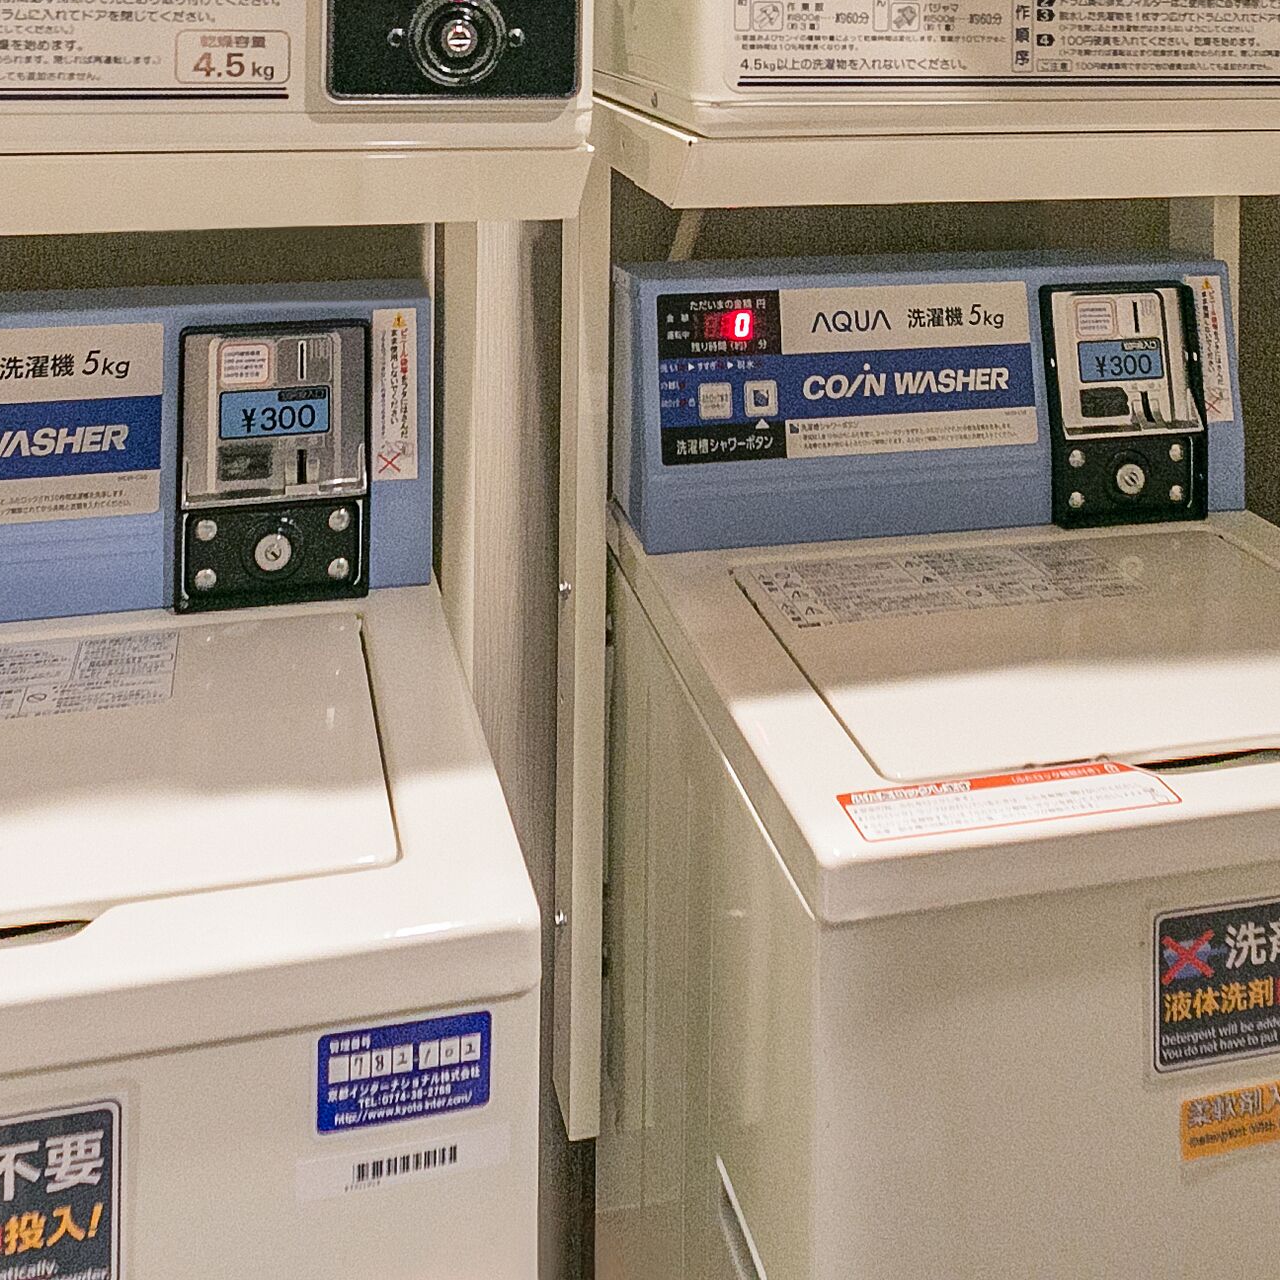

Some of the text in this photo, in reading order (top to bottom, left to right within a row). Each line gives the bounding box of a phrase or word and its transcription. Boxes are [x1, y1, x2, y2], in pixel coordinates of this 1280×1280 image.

[756, 299, 766, 309] 円
[907, 303, 1005, 330] 洗濯機 5kg
[734, 313, 750, 337] 0
[811, 309, 892, 334] AQUA
[758, 339, 767, 349] 分
[0, 349, 132, 380] 洗濯機 5kg
[1096, 354, 1152, 378] ¥300
[894, 367, 1009, 395] WASHER
[242, 405, 315, 433] ¥300
[1218, 1023, 1238, 1036] will
[1240, 1020, 1254, 1032] be
[1162, 1047, 1183, 1060] You
[1183, 1044, 1199, 1056] do
[1200, 1041, 1218, 1055] not
[1220, 1038, 1246, 1052] have
[1247, 1035, 1259, 1046] to
